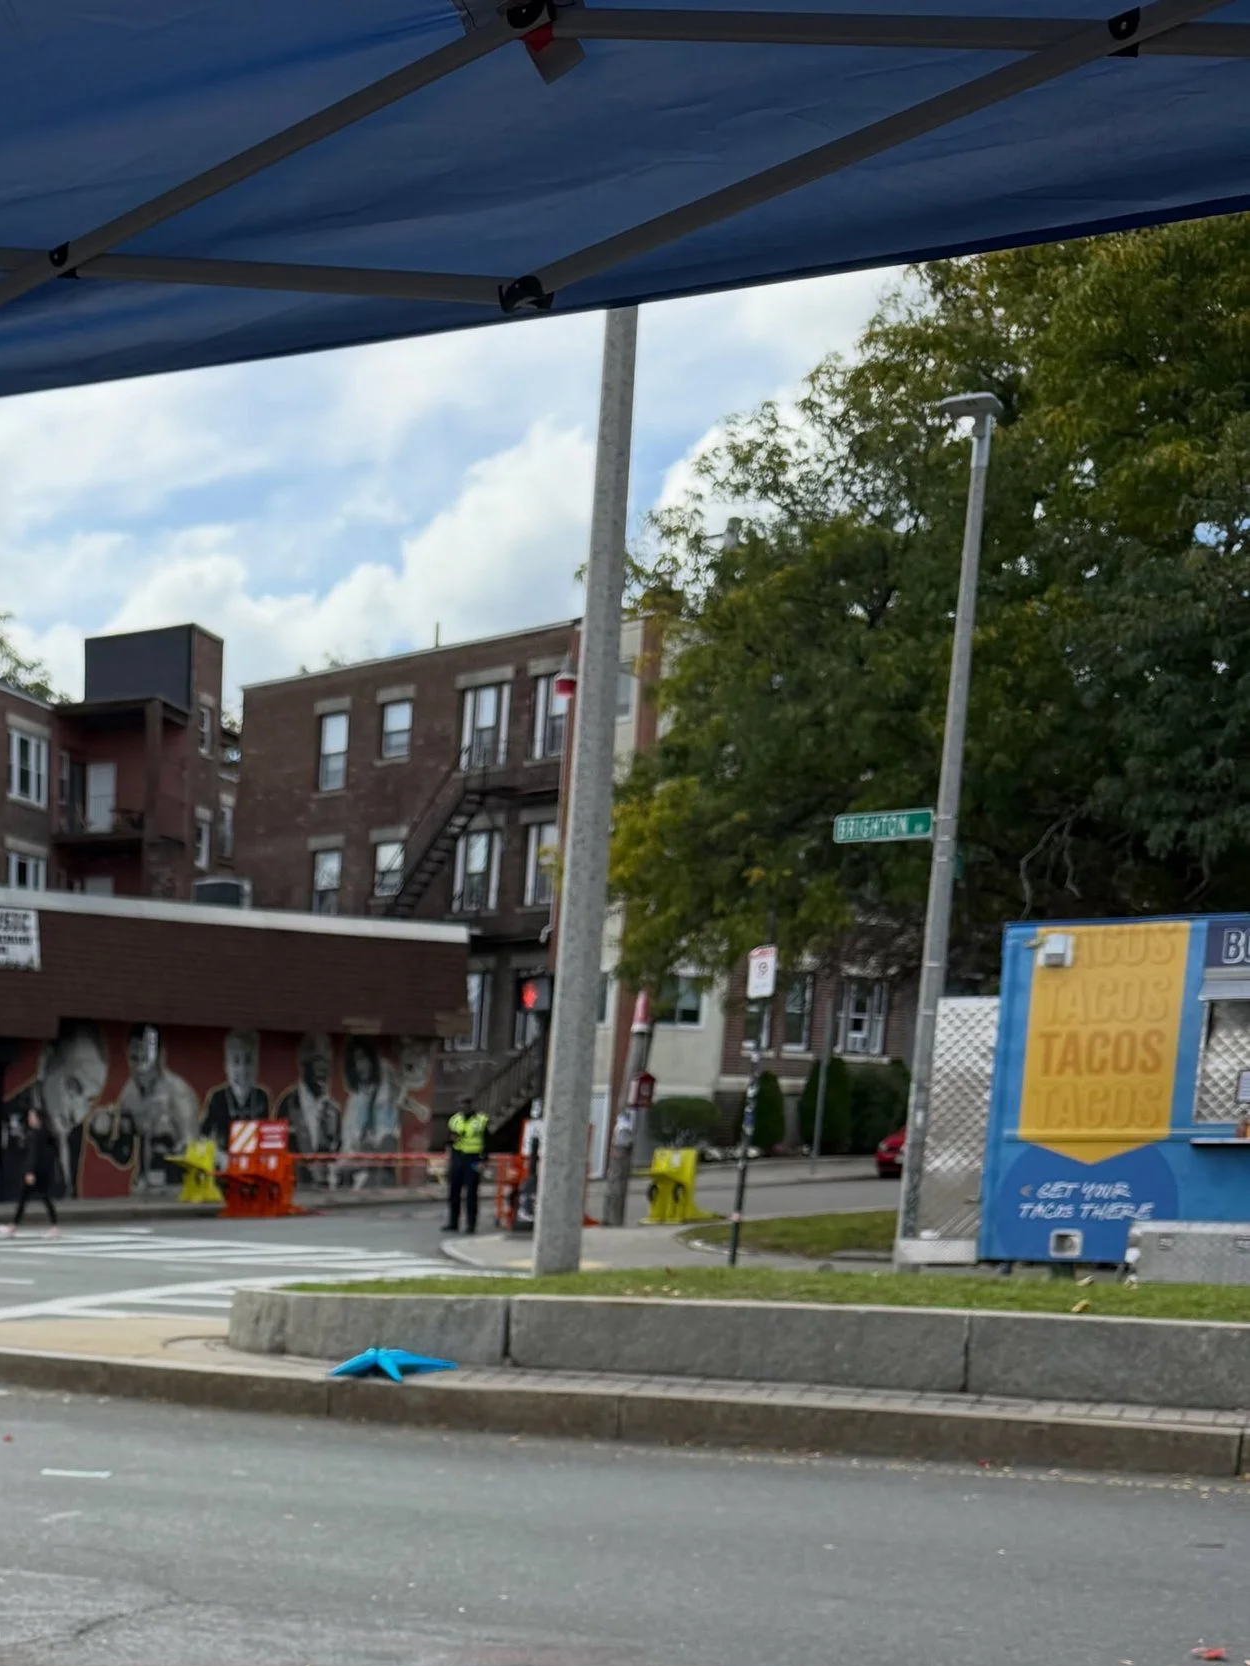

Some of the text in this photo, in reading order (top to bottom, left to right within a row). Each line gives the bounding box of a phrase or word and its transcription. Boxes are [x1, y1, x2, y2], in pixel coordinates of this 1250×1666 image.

[1072, 926, 1180, 968] ACOS
[1041, 974, 1173, 1027] TACOS
[1038, 1030, 1165, 1077] TACOS
[1031, 1081, 1166, 1130] TACOS
[1018, 1202, 1155, 1220] TACOS THERE
[1036, 1181, 1132, 1199] GET YOUR
